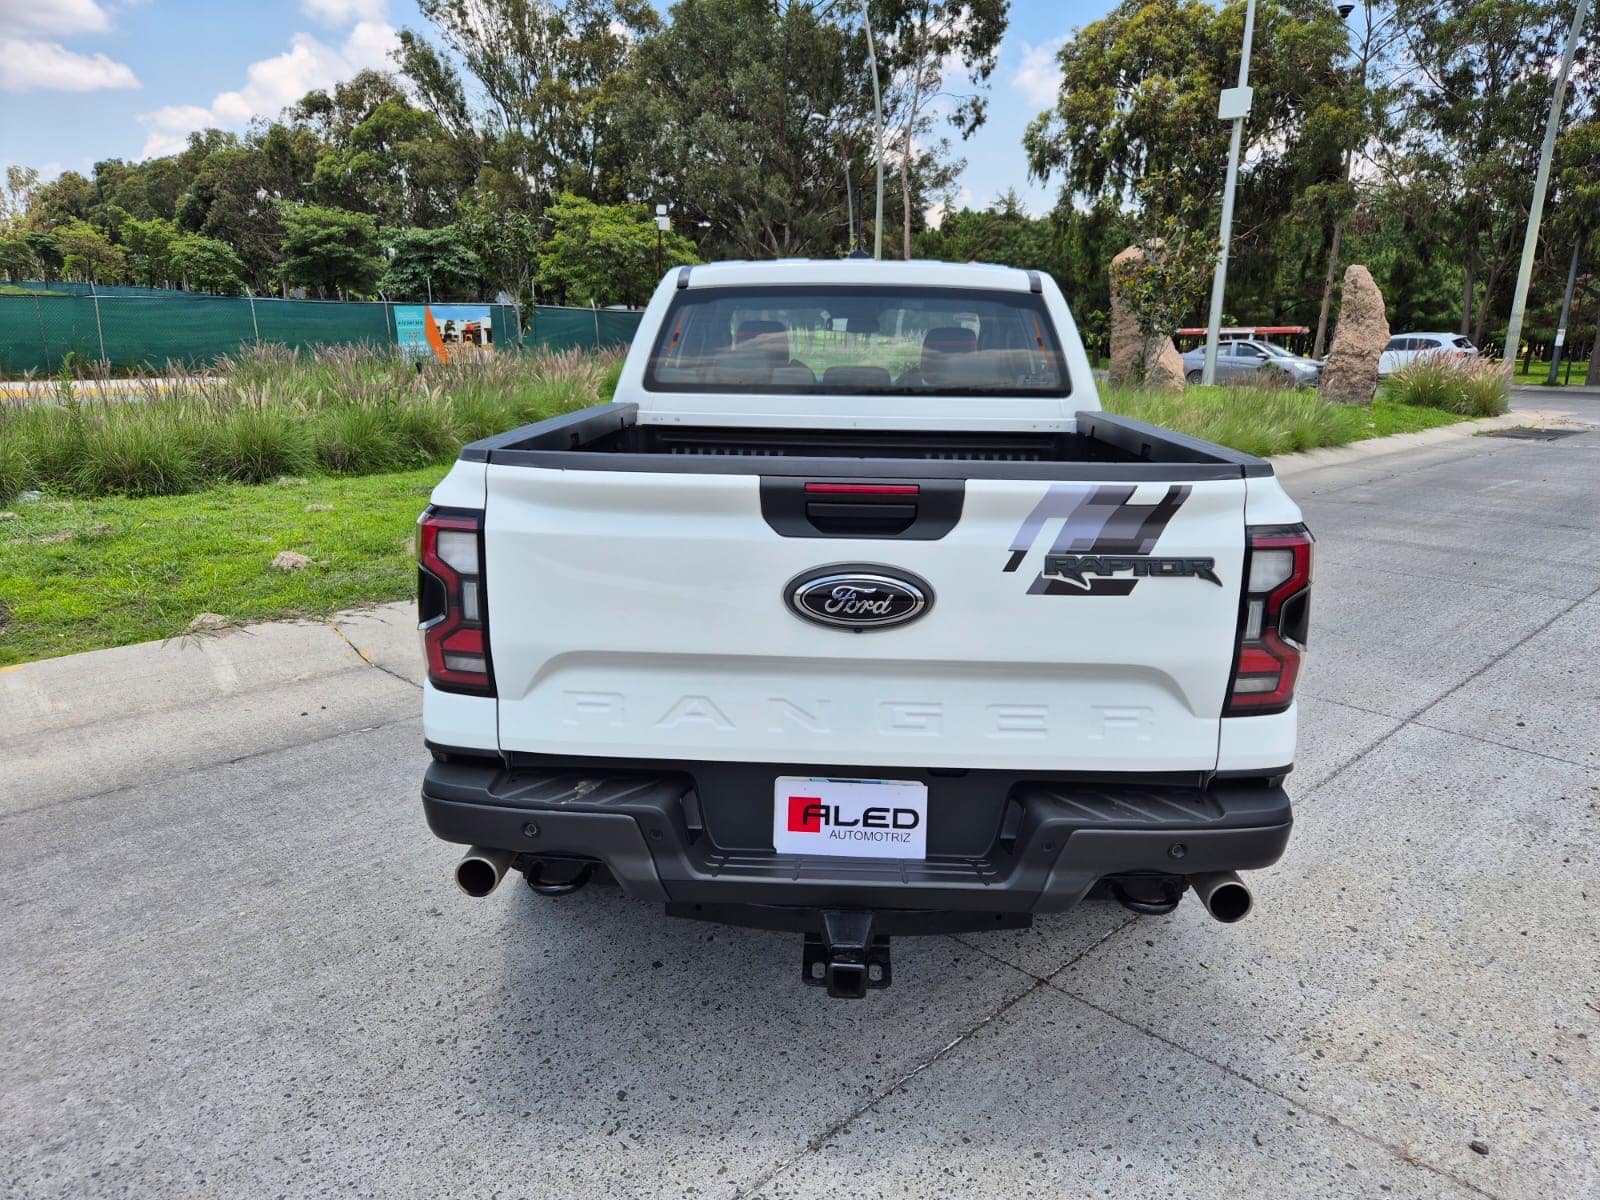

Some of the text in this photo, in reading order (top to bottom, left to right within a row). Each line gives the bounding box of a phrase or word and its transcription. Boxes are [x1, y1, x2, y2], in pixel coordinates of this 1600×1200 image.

[1044, 555, 1223, 590] RAPTOR
[825, 585, 894, 614] Ford
[561, 690, 1155, 742] RANGER
[802, 804, 920, 830] ALED
[829, 829, 911, 843] AUTOMOTRIZ
